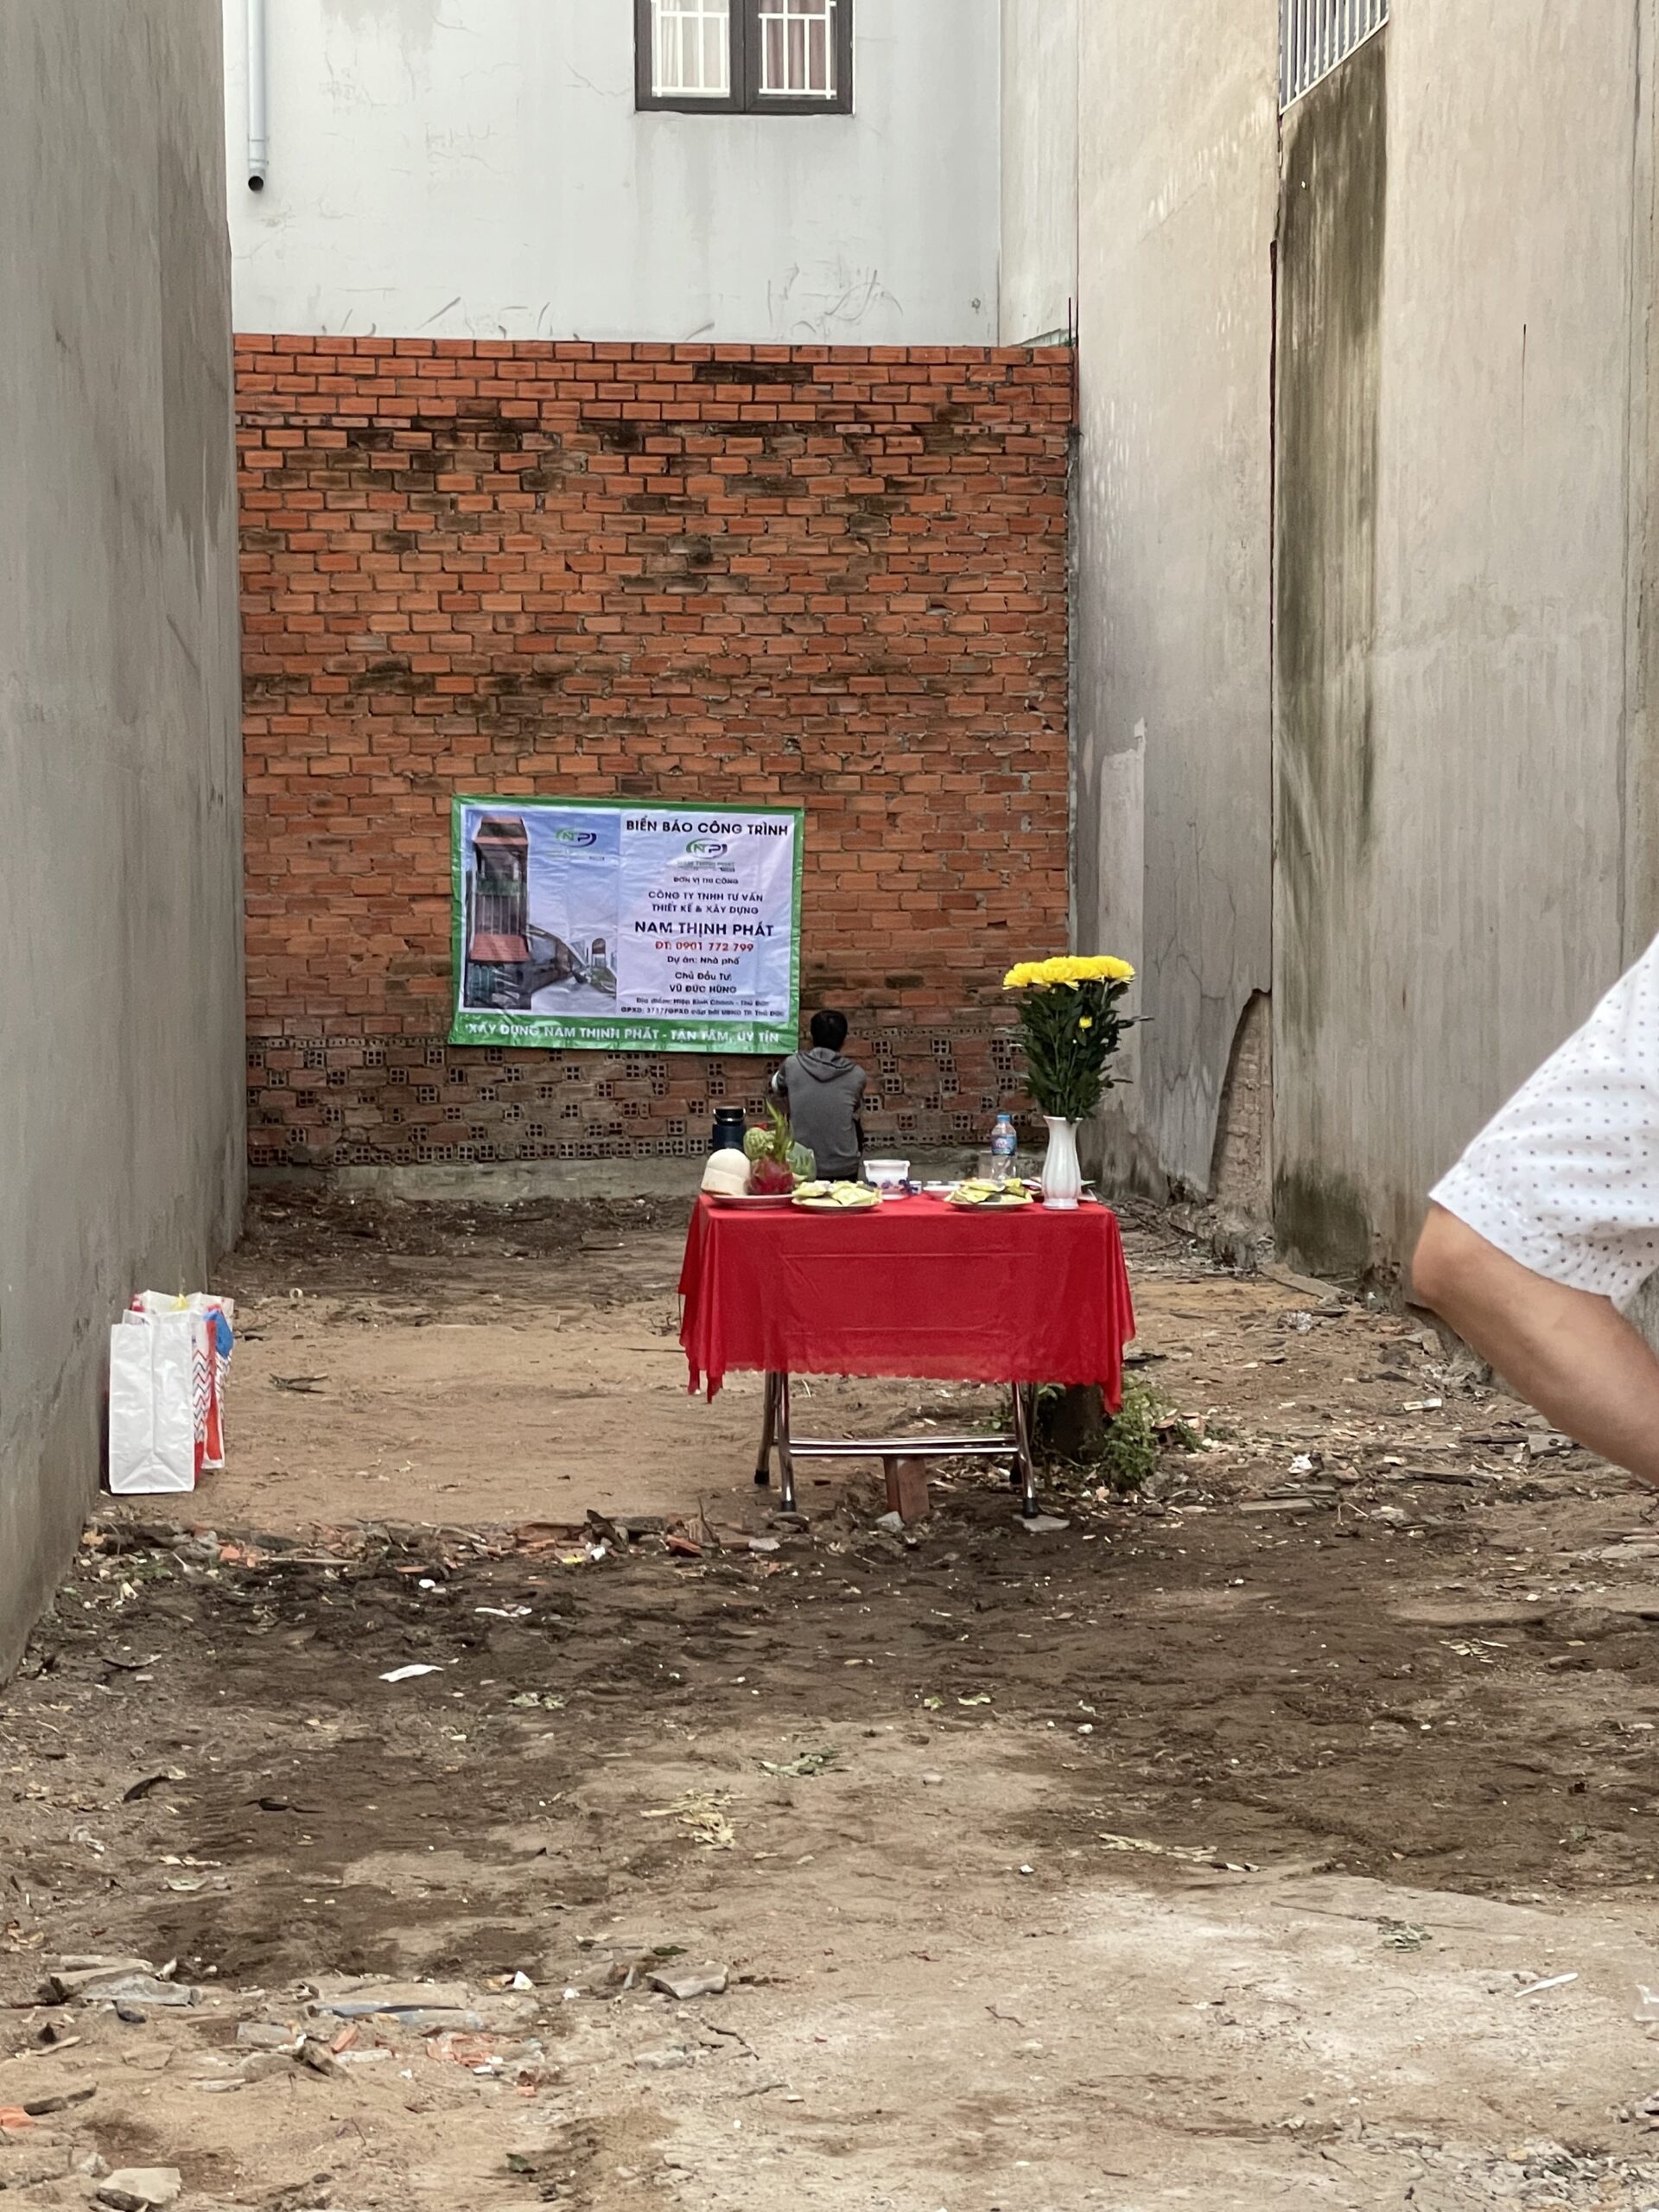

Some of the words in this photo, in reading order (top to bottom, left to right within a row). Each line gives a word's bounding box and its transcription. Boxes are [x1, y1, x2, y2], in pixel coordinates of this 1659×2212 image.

[626, 816, 657, 831] BIỂN
[663, 819, 693, 832] BÁO
[698, 820, 742, 835] CÔNG
[747, 820, 788, 836] TRÌNH
[648, 889, 679, 899] CÔNG
[683, 892, 695, 900] TY
[698, 892, 724, 901] TNHH
[728, 892, 739, 901] TƯ
[741, 890, 763, 902] VẤN
[652, 901, 677, 912] THIẾT
[681, 903, 693, 912] KẾ
[706, 904, 726, 913] XÂY
[729, 906, 759, 917] DỰNG
[635, 921, 672, 933] NAM
[678, 923, 727, 938] THỊNH
[733, 921, 774, 936] PHÁT
[676, 941, 702, 951] 0901
[709, 942, 729, 951] 772
[733, 943, 754, 952] 799
[667, 956, 679, 965] Dự
[700, 956, 719, 964] Nhà
[721, 956, 741, 966] phố
[675, 969, 694, 980] Chủ
[697, 971, 716, 981] Đầu
[670, 983, 683, 993] VŨ
[685, 983, 706, 994] ĐỨC
[709, 984, 737, 995] HÙNG
[544, 1027, 575, 1038] NAM
[580, 1027, 620, 1041] THỊNH
[625, 1027, 659, 1039] PHÁT
[671, 1029, 696, 1044] TẬN
